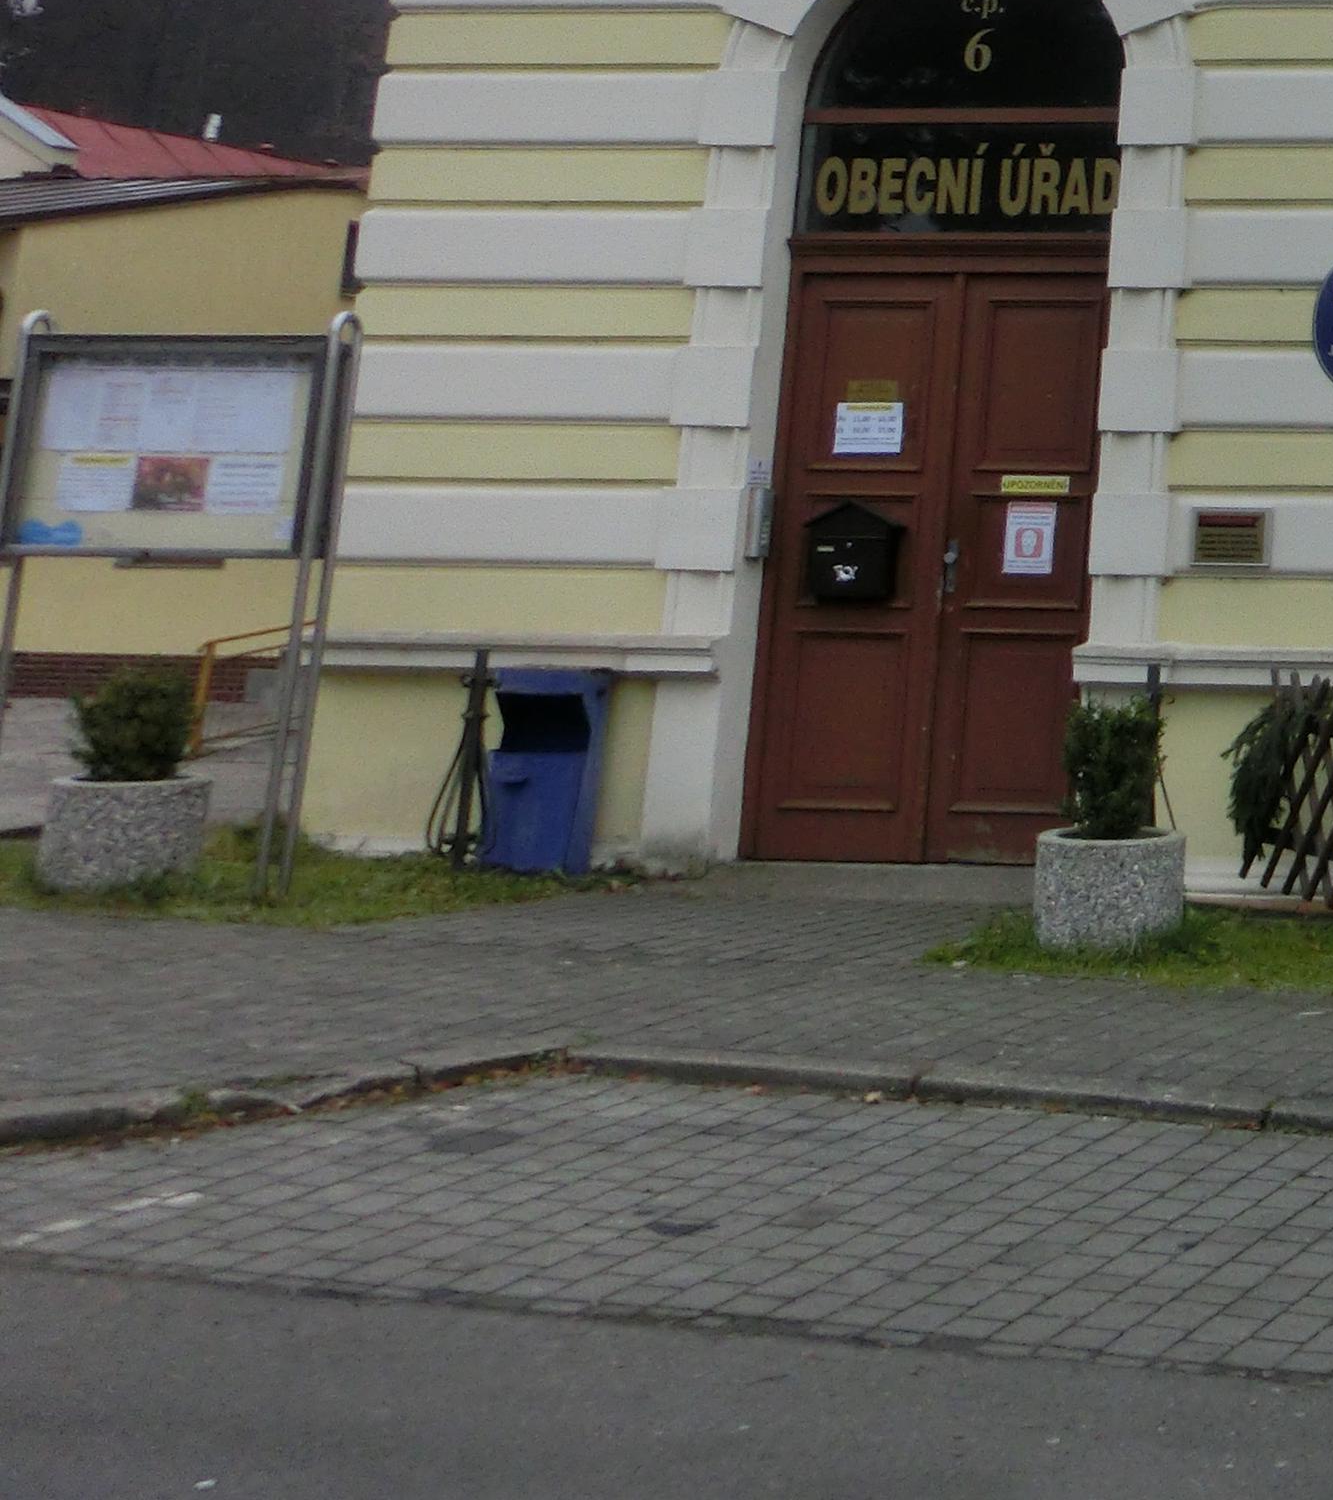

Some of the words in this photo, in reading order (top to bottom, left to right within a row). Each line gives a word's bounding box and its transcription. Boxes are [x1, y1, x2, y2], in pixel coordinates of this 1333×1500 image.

[963, 28, 995, 72] 6
[815, 142, 989, 216] OBECNÍ
[999, 143, 1121, 217] ÚŘAD
